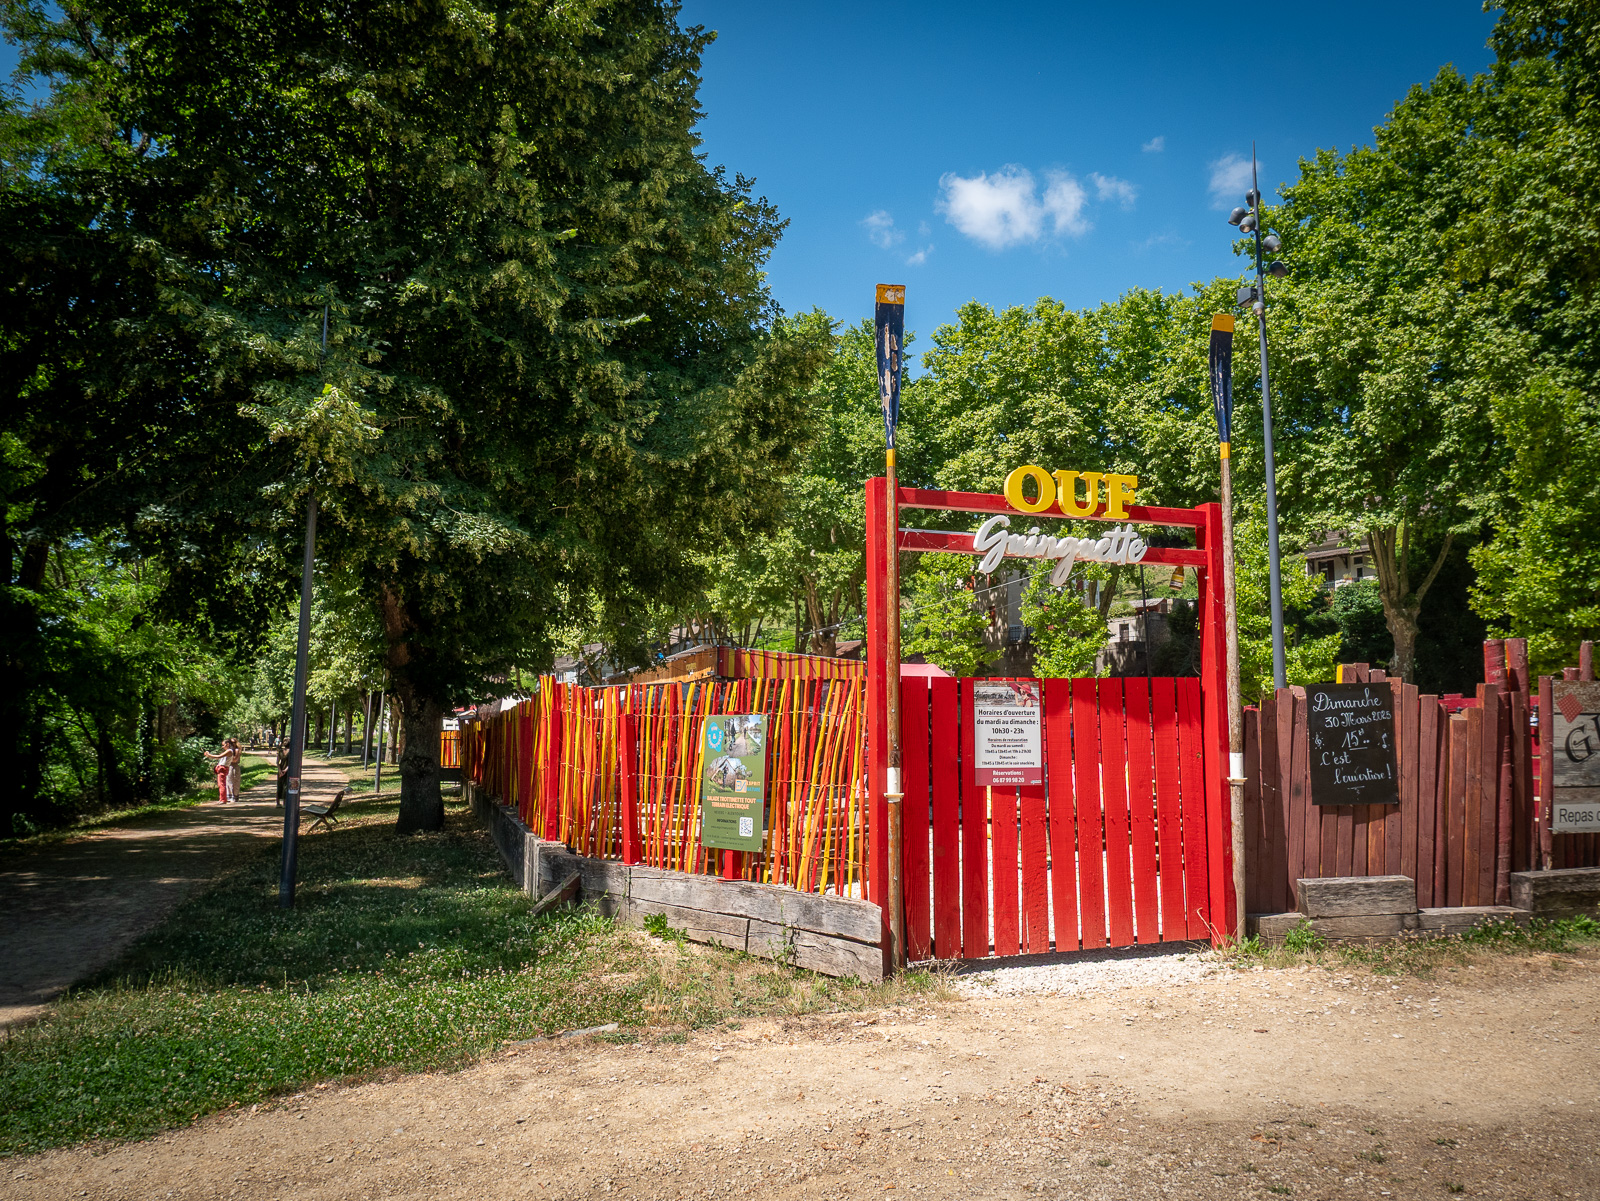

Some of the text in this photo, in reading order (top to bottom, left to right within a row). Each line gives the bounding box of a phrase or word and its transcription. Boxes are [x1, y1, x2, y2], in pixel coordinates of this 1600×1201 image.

[1004, 465, 1138, 519] OUF
[973, 514, 1147, 586] Guinguette
[1312, 687, 1382, 712] Dimanche
[1324, 710, 1392, 728] 30 Mars 2025
[1320, 751, 1351, 766] C'est
[1559, 808, 1593, 825] Repas
